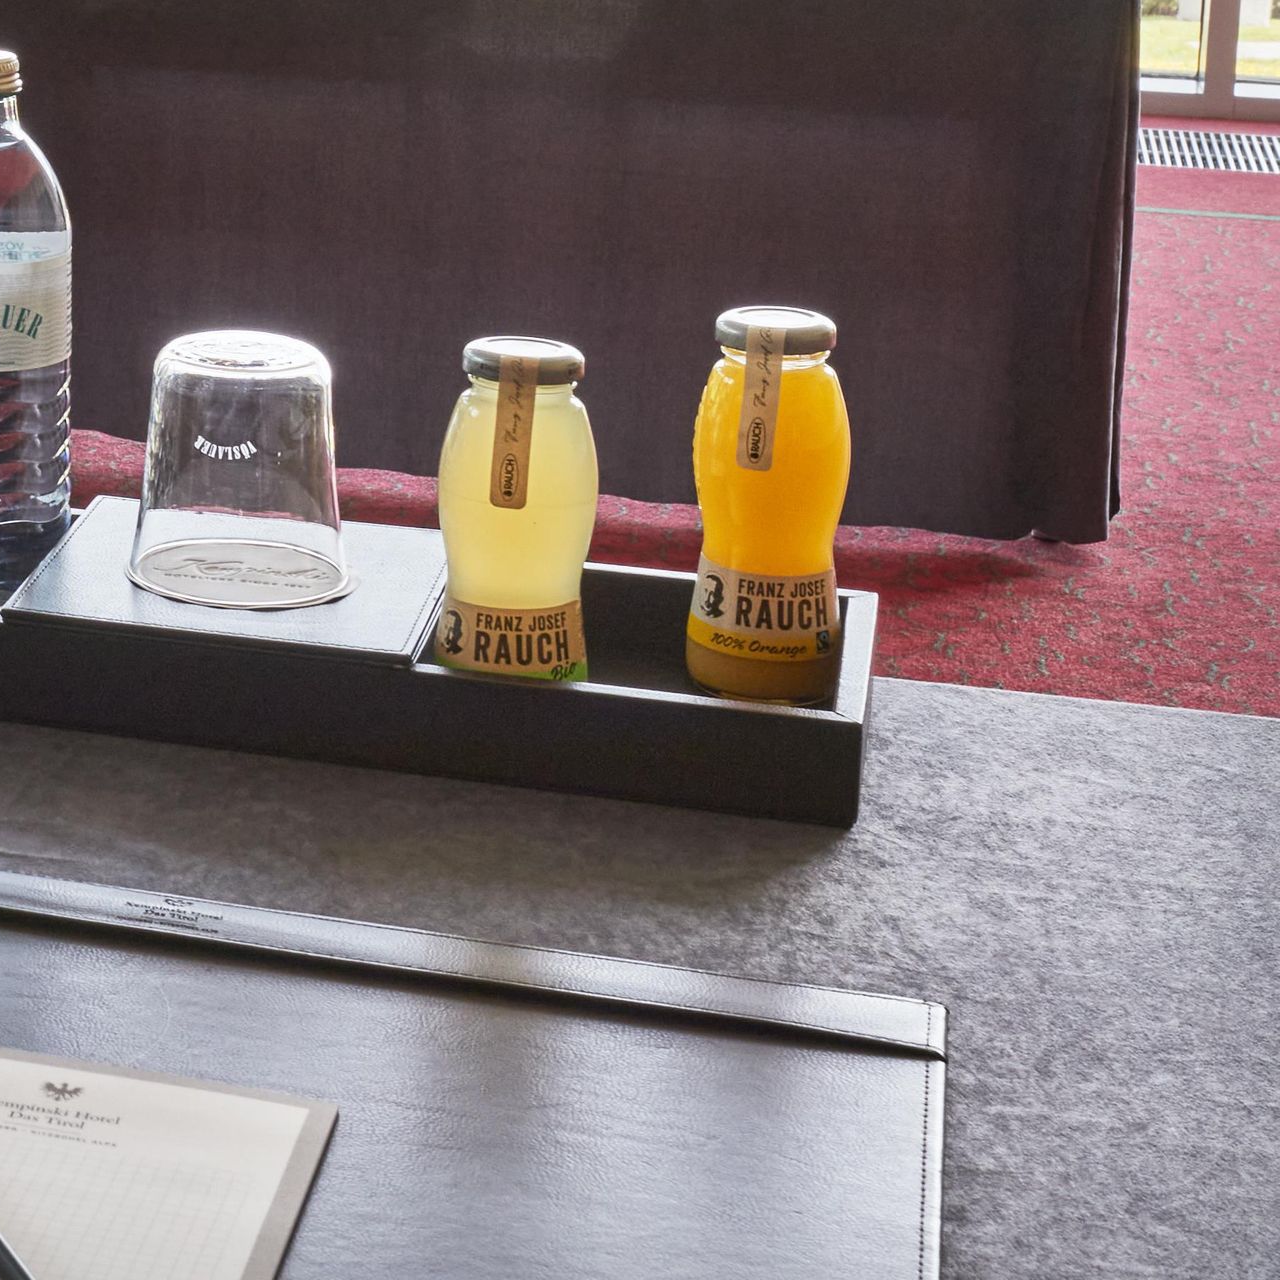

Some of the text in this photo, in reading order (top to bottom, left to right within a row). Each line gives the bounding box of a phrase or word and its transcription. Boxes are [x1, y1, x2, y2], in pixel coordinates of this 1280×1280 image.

[194, 435, 258, 461] VÖSLAUER
[751, 421, 763, 452] RAUCH
[503, 459, 515, 490] RAUCH
[738, 578, 826, 598] FRANZ JOSEF
[476, 611, 567, 632] FRANZ JOSEF
[735, 595, 828, 631] RAUCH
[473, 630, 570, 666] RAUCH
[710, 632, 807, 658] 100% Orange
[551, 661, 577, 681] Bio
[8, 1110, 86, 1130] Das Tirol
[75, 1110, 122, 1126] Hotel
